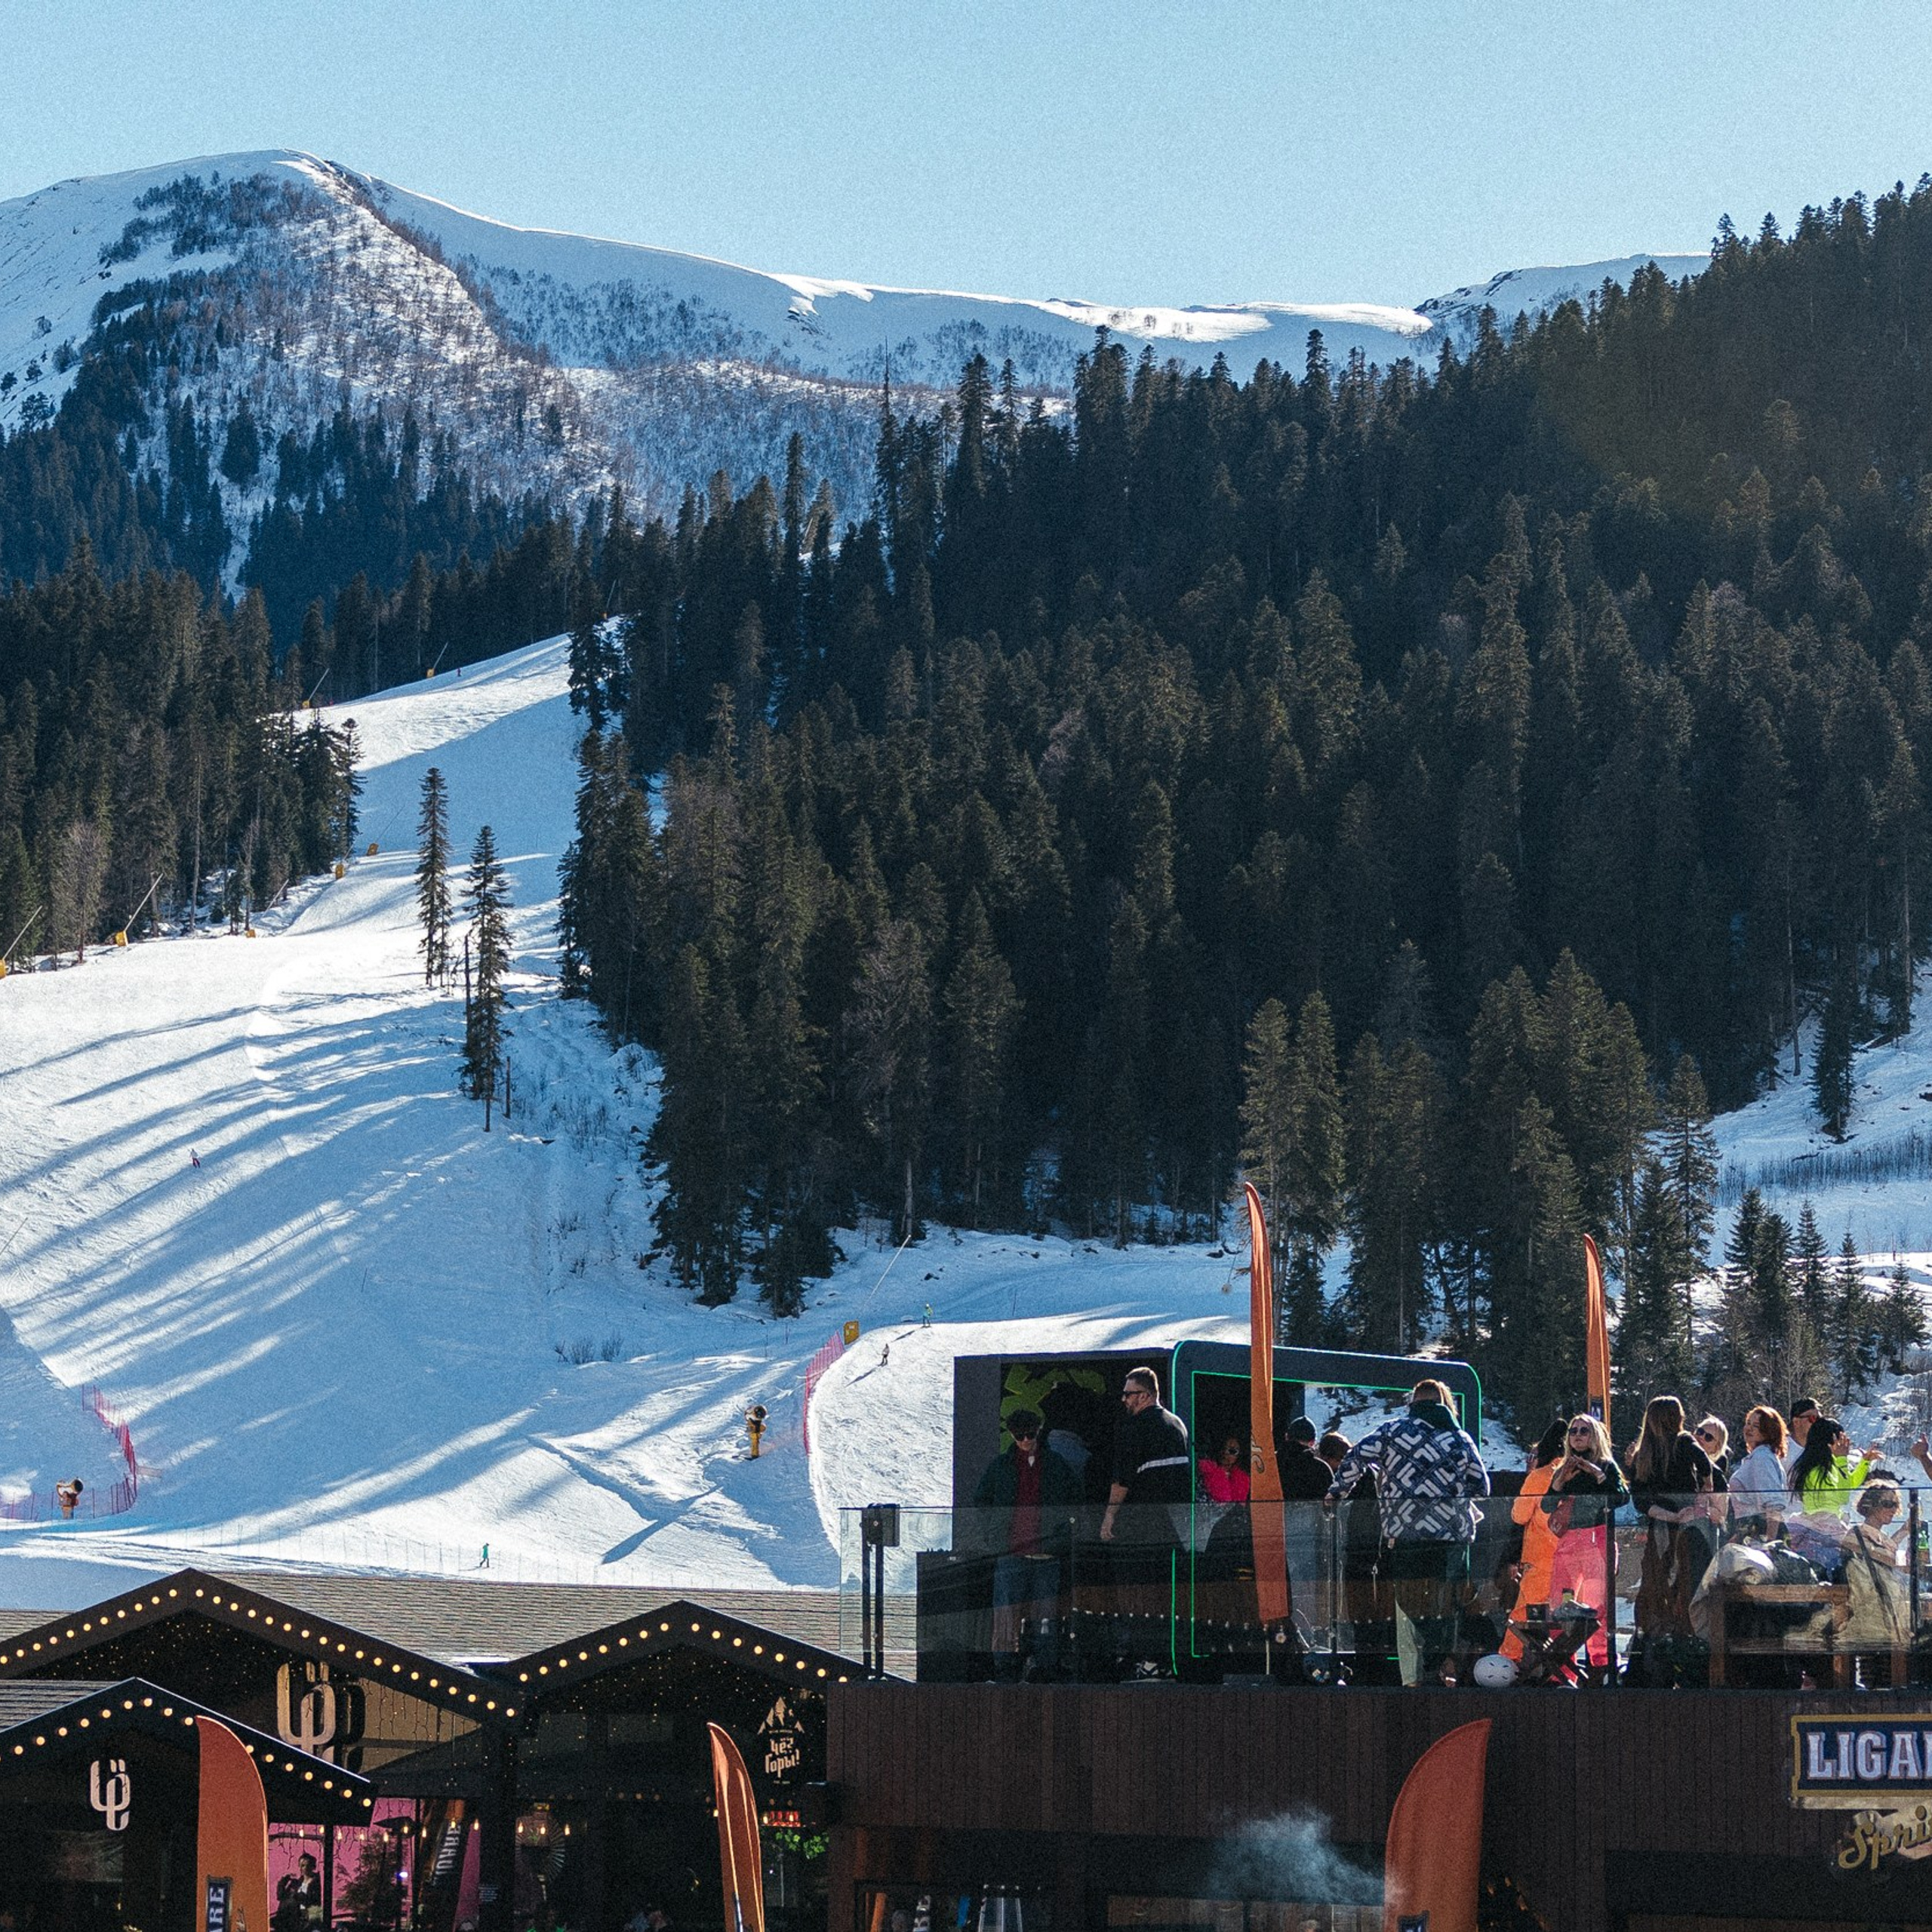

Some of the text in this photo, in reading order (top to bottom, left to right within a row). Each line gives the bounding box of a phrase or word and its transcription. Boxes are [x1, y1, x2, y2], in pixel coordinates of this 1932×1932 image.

[764, 1748, 800, 1778] Горы!
[1838, 1805, 1932, 1870] Spri
[208, 1887, 225, 1932] RE
